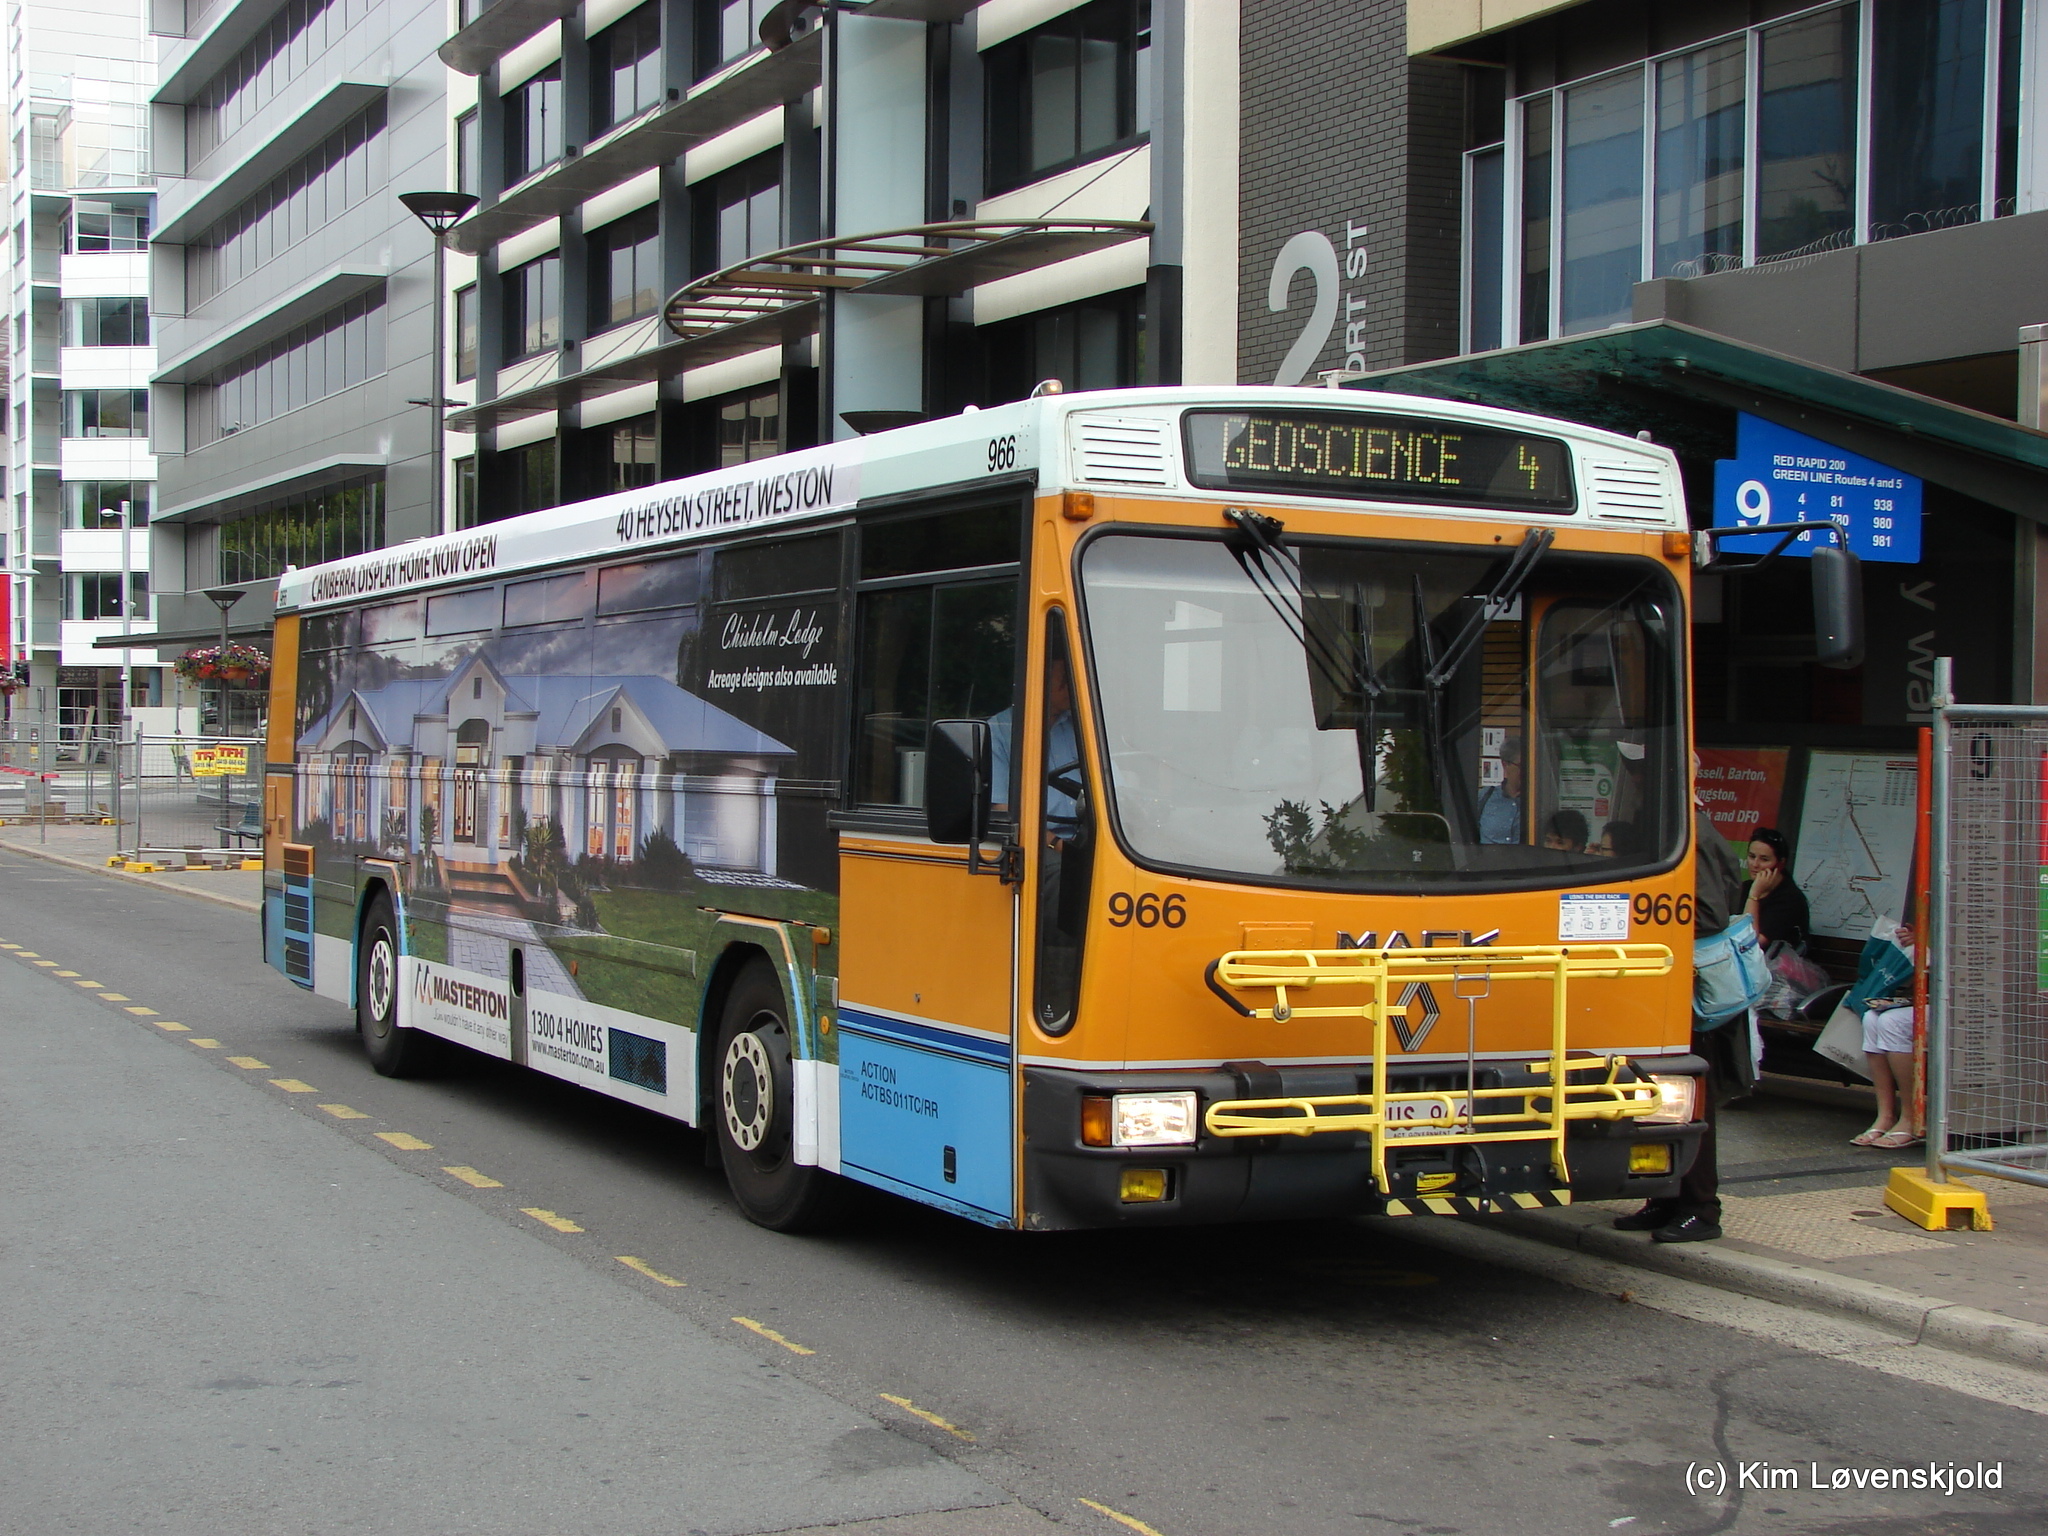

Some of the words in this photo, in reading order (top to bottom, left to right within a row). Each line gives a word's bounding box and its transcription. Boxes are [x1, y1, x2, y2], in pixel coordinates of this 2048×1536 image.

[1346, 219, 1368, 280] ST
[1268, 230, 1340, 387] 2
[1344, 292, 1367, 373] ORT
[987, 434, 1016, 472] 966
[1222, 416, 1462, 485] GEOSCIENCE
[1518, 445, 1540, 490] 4
[1773, 455, 1794, 467] RED
[1796, 457, 1827, 469] RAPID
[1829, 460, 1846, 471] 200
[1772, 469, 1808, 482] GREEN
[1810, 472, 1833, 484] LINE
[1834, 474, 1867, 487] Routes
[1868, 477, 1875, 487] 4
[1876, 479, 1894, 489] and
[1895, 479, 1903, 489] 5
[616, 507, 634, 542] 40
[636, 493, 693, 539] HEYSEN
[695, 480, 754, 528] STREET,
[757, 464, 834, 517] WESTON
[1736, 480, 1771, 536] 9
[1797, 493, 1806, 505] 4
[1830, 495, 1843, 508] 81
[1873, 499, 1893, 511] 938
[1797, 511, 1805, 523] 5
[1872, 517, 1893, 530] 980
[1872, 535, 1891, 547] 981
[311, 566, 356, 602] CANBERRA
[358, 555, 399, 593] DISPLAY
[399, 547, 432, 585] HOME
[433, 540, 463, 578] NOW
[463, 533, 498, 572] OPEN
[721, 612, 779, 650] Chisholm
[779, 608, 823, 660] Lodge
[707, 669, 742, 693] Acreage
[741, 666, 774, 693] designs
[774, 665, 794, 687] also
[794, 662, 838, 686] available
[1697, 766, 1724, 782] ssell,
[1727, 767, 1767, 783] Barton,
[1970, 732, 1992, 781] 9
[1714, 810, 1736, 822] and
[1736, 810, 1760, 824] DFO
[1108, 892, 1187, 928] 966
[1633, 893, 1693, 926] 966
[433, 976, 507, 1020] MASTERTON
[531, 1009, 555, 1039] 1300
[557, 1020, 563, 1042] 4
[565, 1017, 603, 1053] HOMES
[531, 1038, 605, 1075] www.masterton.com.au
[861, 1061, 896, 1085] ACTION
[1385, 1105, 1415, 1131] US
